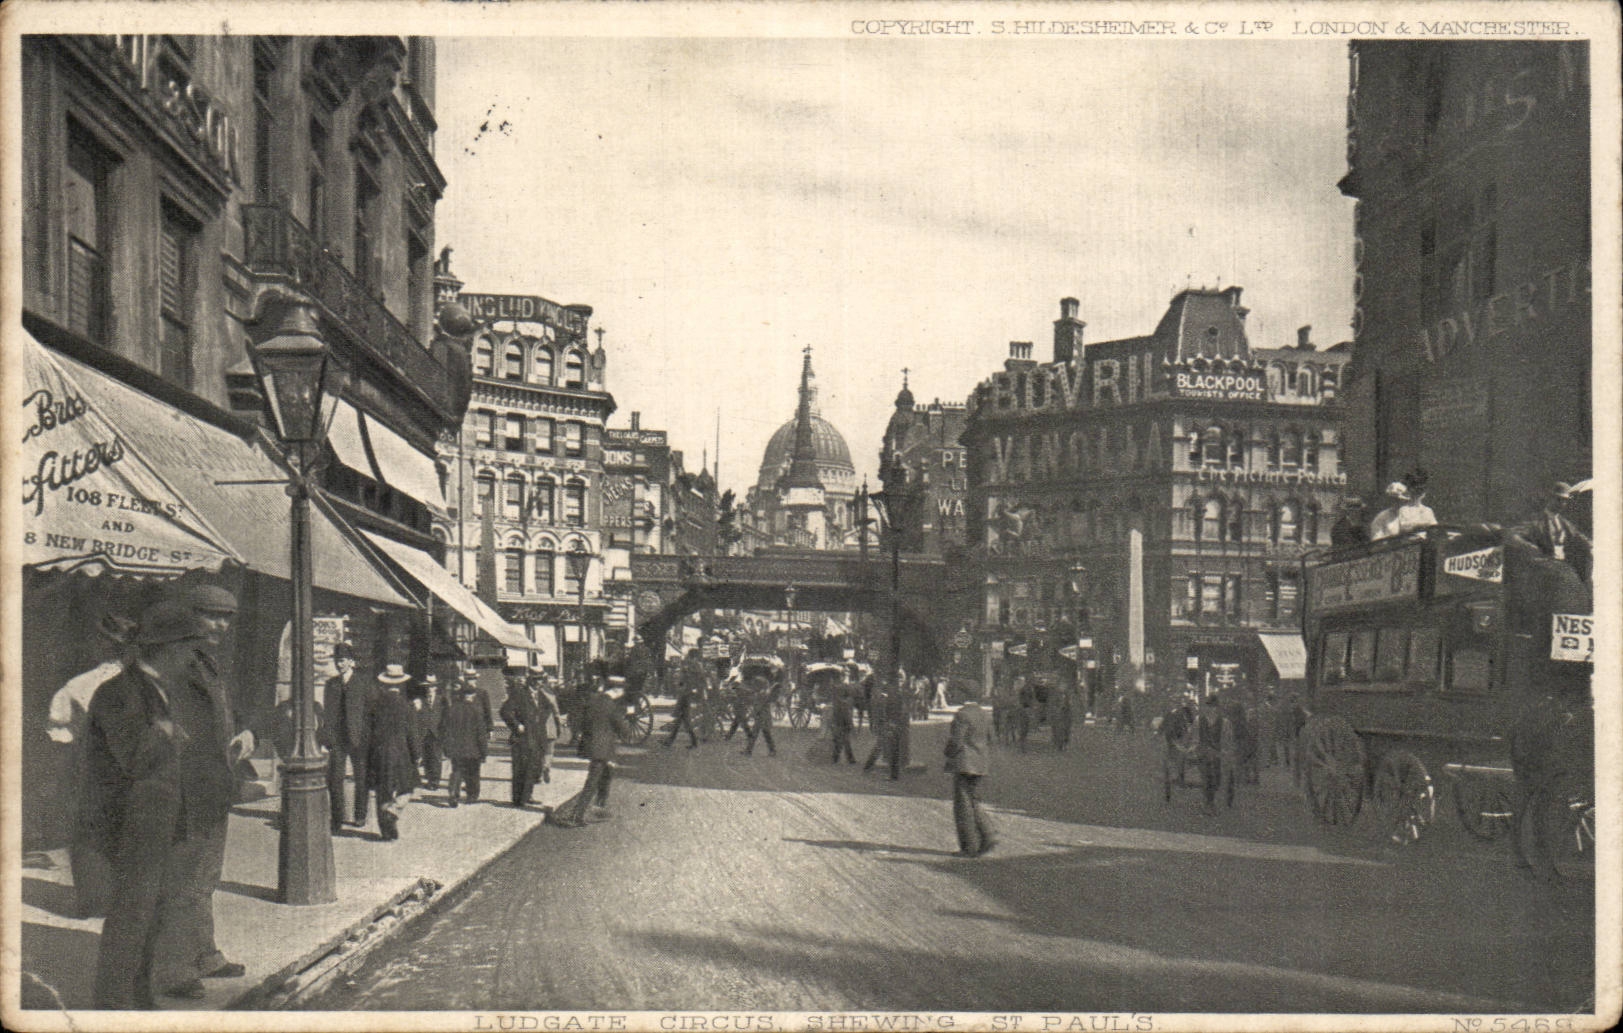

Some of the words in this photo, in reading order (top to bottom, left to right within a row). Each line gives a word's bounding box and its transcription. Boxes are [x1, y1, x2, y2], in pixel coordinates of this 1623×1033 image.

[992, 352, 1171, 414] BOVRIL
[1176, 372, 1265, 392] BLACKPOOL
[1179, 389, 1224, 398] TOURISTS
[1228, 391, 1262, 400] OFFICE
[22, 436, 124, 517] fitters
[67, 486, 102, 506] 108
[107, 493, 162, 515] FLEET
[101, 520, 135, 533] AND
[45, 533, 86, 552] NEW
[90, 539, 159, 562] BRIDGE
